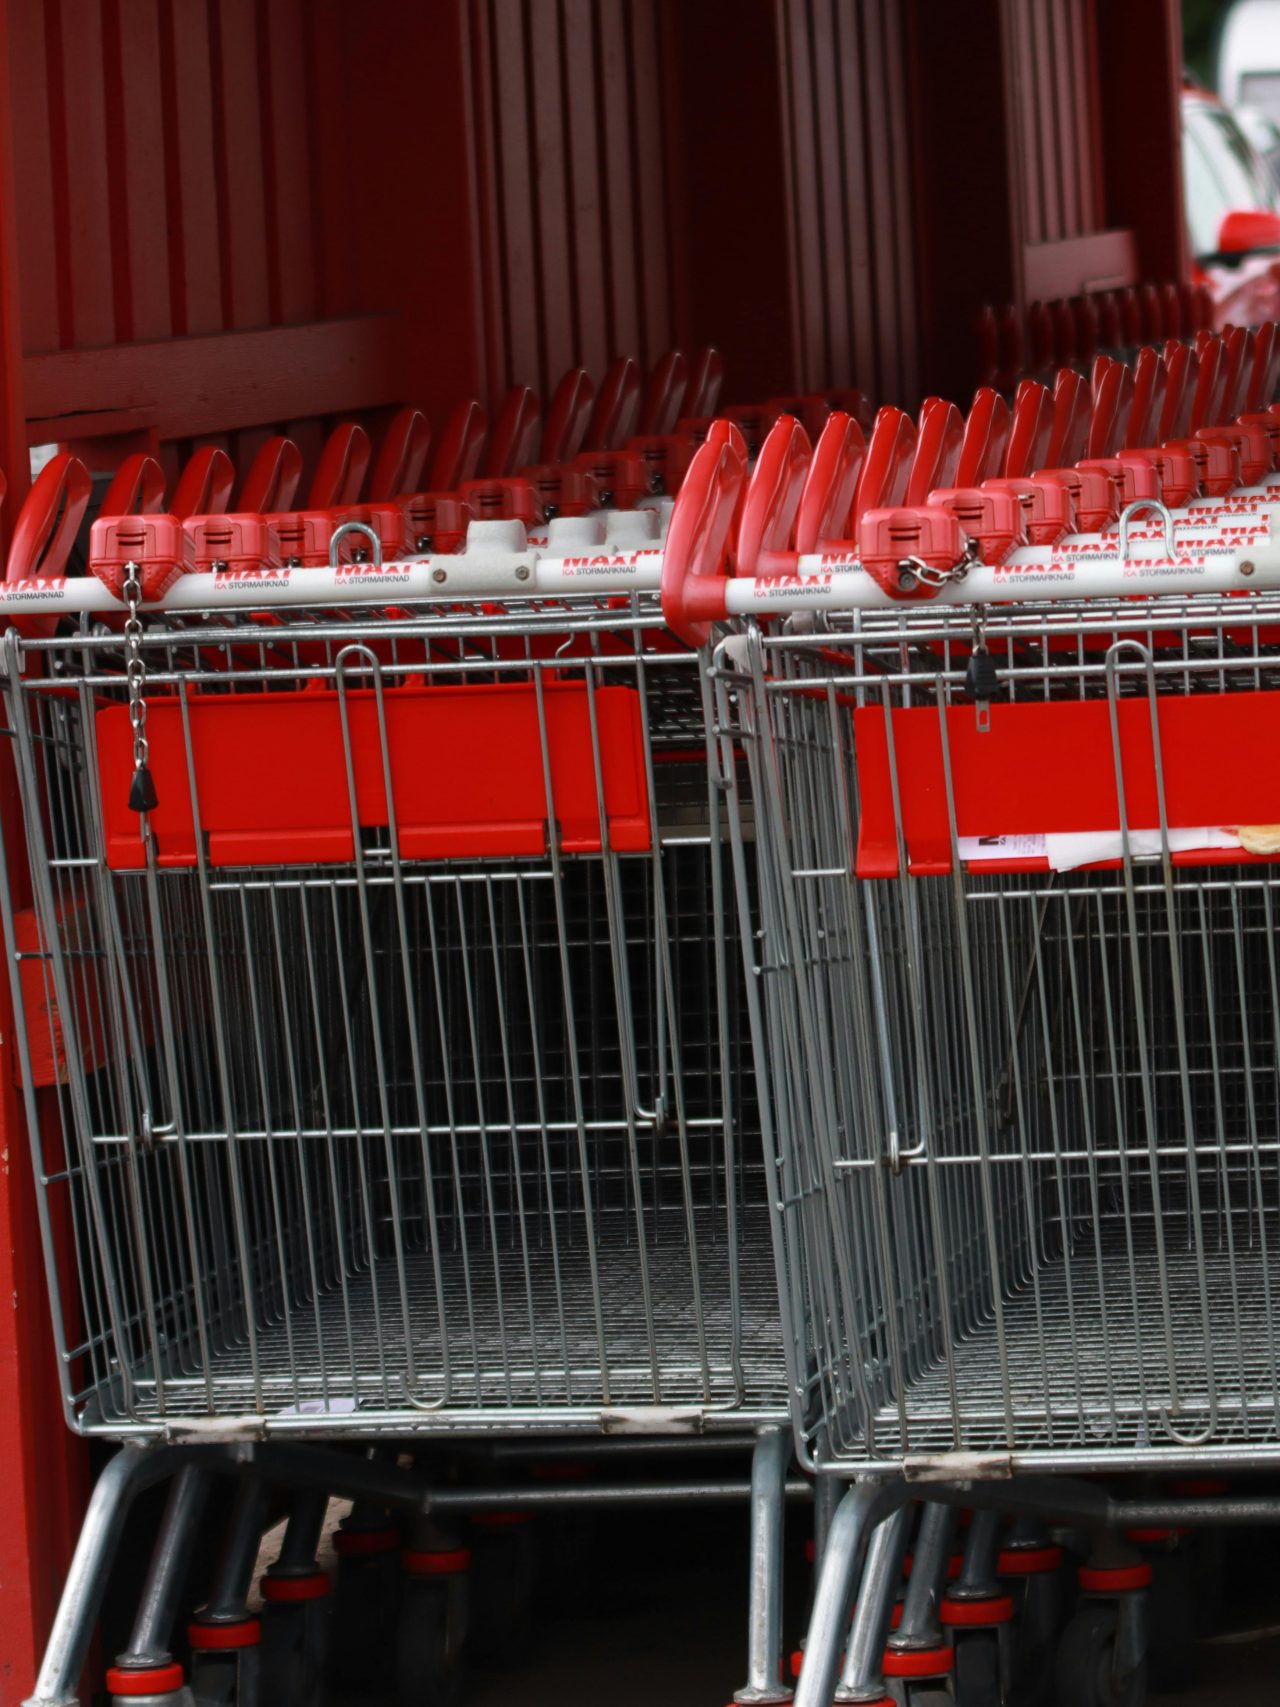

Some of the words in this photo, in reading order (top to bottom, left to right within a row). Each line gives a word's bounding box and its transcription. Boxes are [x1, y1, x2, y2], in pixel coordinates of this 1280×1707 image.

[1188, 504, 1257, 515] MAXI
[1221, 526, 1268, 535] MA
[1176, 537, 1255, 548] MAXI
[1052, 543, 1118, 554] MAX
[1191, 548, 1237, 557] STORMARK
[563, 556, 638, 567] MAXI
[821, 553, 861, 564] MA
[1124, 557, 1205, 568] MAXI
[335, 564, 411, 576] MAXI
[576, 567, 636, 576] STORMARKNAD
[994, 563, 1075, 575] MAXI
[1139, 567, 1205, 577] STORMARKNAD
[215, 569, 292, 581] MAXI
[349, 575, 410, 585] STORMARKNAD
[1009, 573, 1075, 583] STORMARKNAD
[229, 580, 289, 590] STORMARKNAD
[755, 575, 832, 588] MAXI
[7, 591, 65, 601] STORMARKNAD
[769, 587, 831, 597] STORMARKNAD
